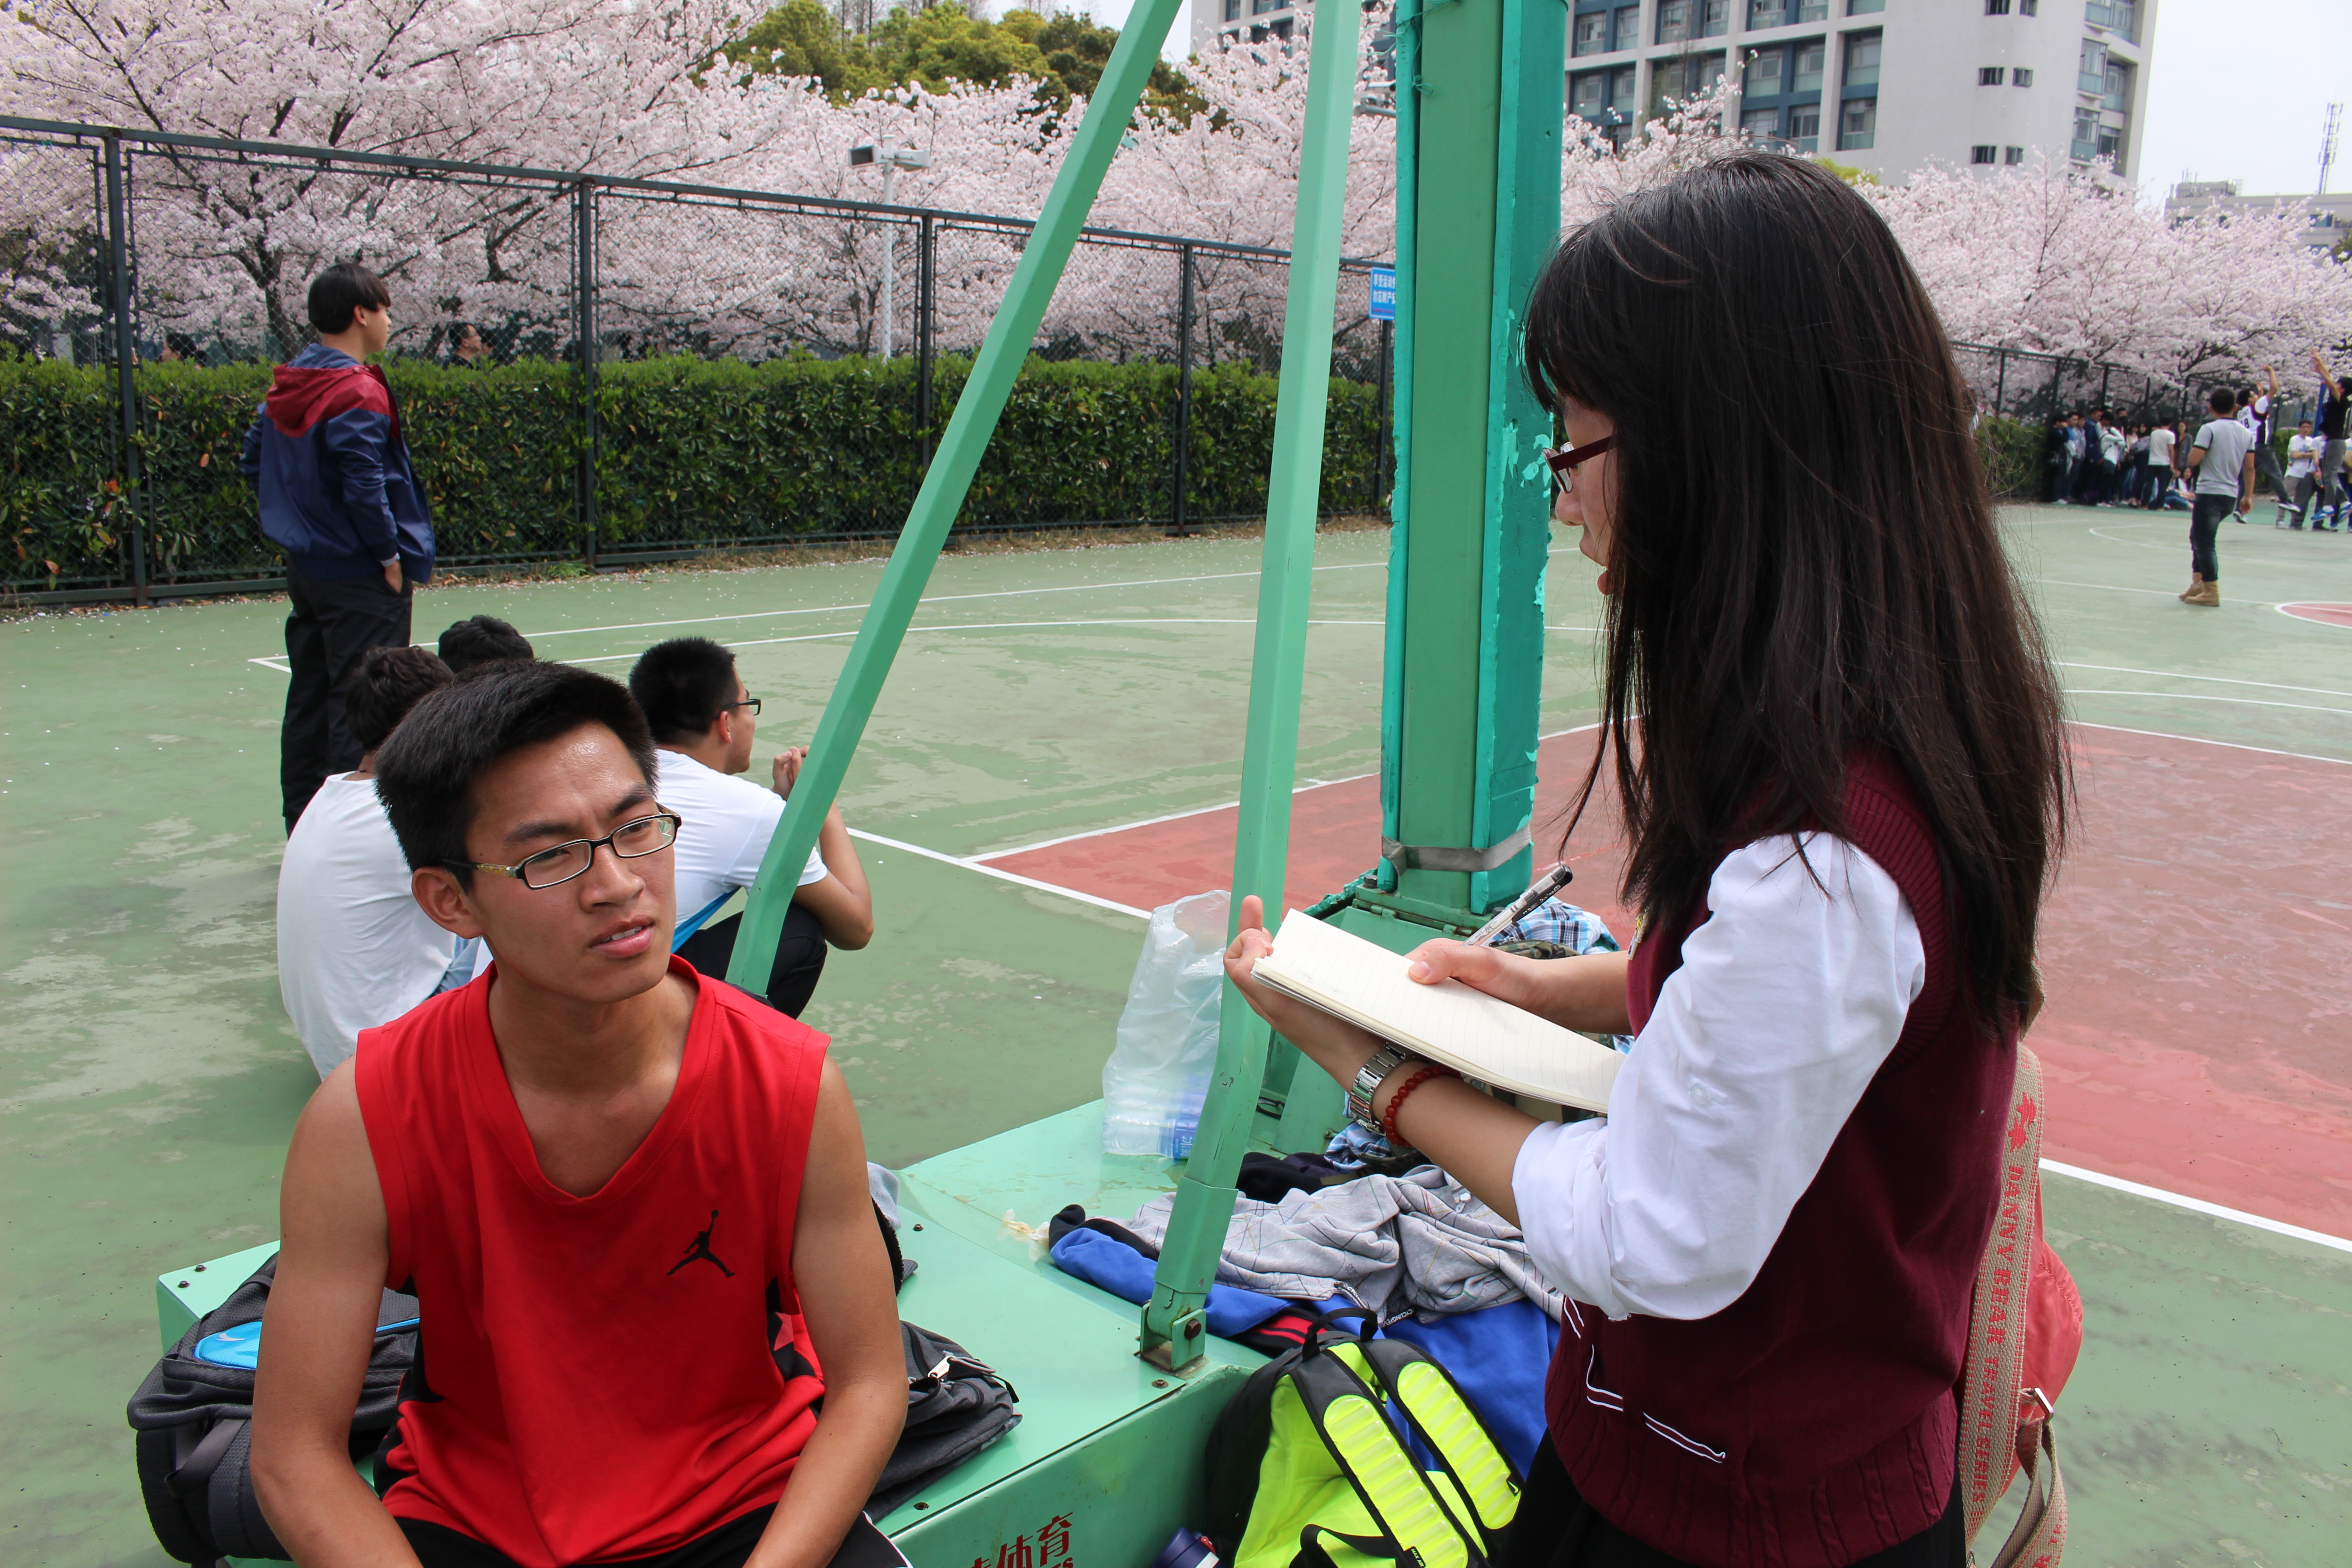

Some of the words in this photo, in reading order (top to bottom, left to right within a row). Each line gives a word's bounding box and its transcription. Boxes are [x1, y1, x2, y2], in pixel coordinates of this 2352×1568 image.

[1996, 1164, 2024, 1264] DANNY
[1987, 1269, 2011, 1345] BEAR
[1977, 1357, 1999, 1432] TRAVEL
[1972, 1436, 1991, 1503] SERIES
[963, 1511, 1073, 1568] 体育
[1411, 1548, 1420, 1559] MAX
